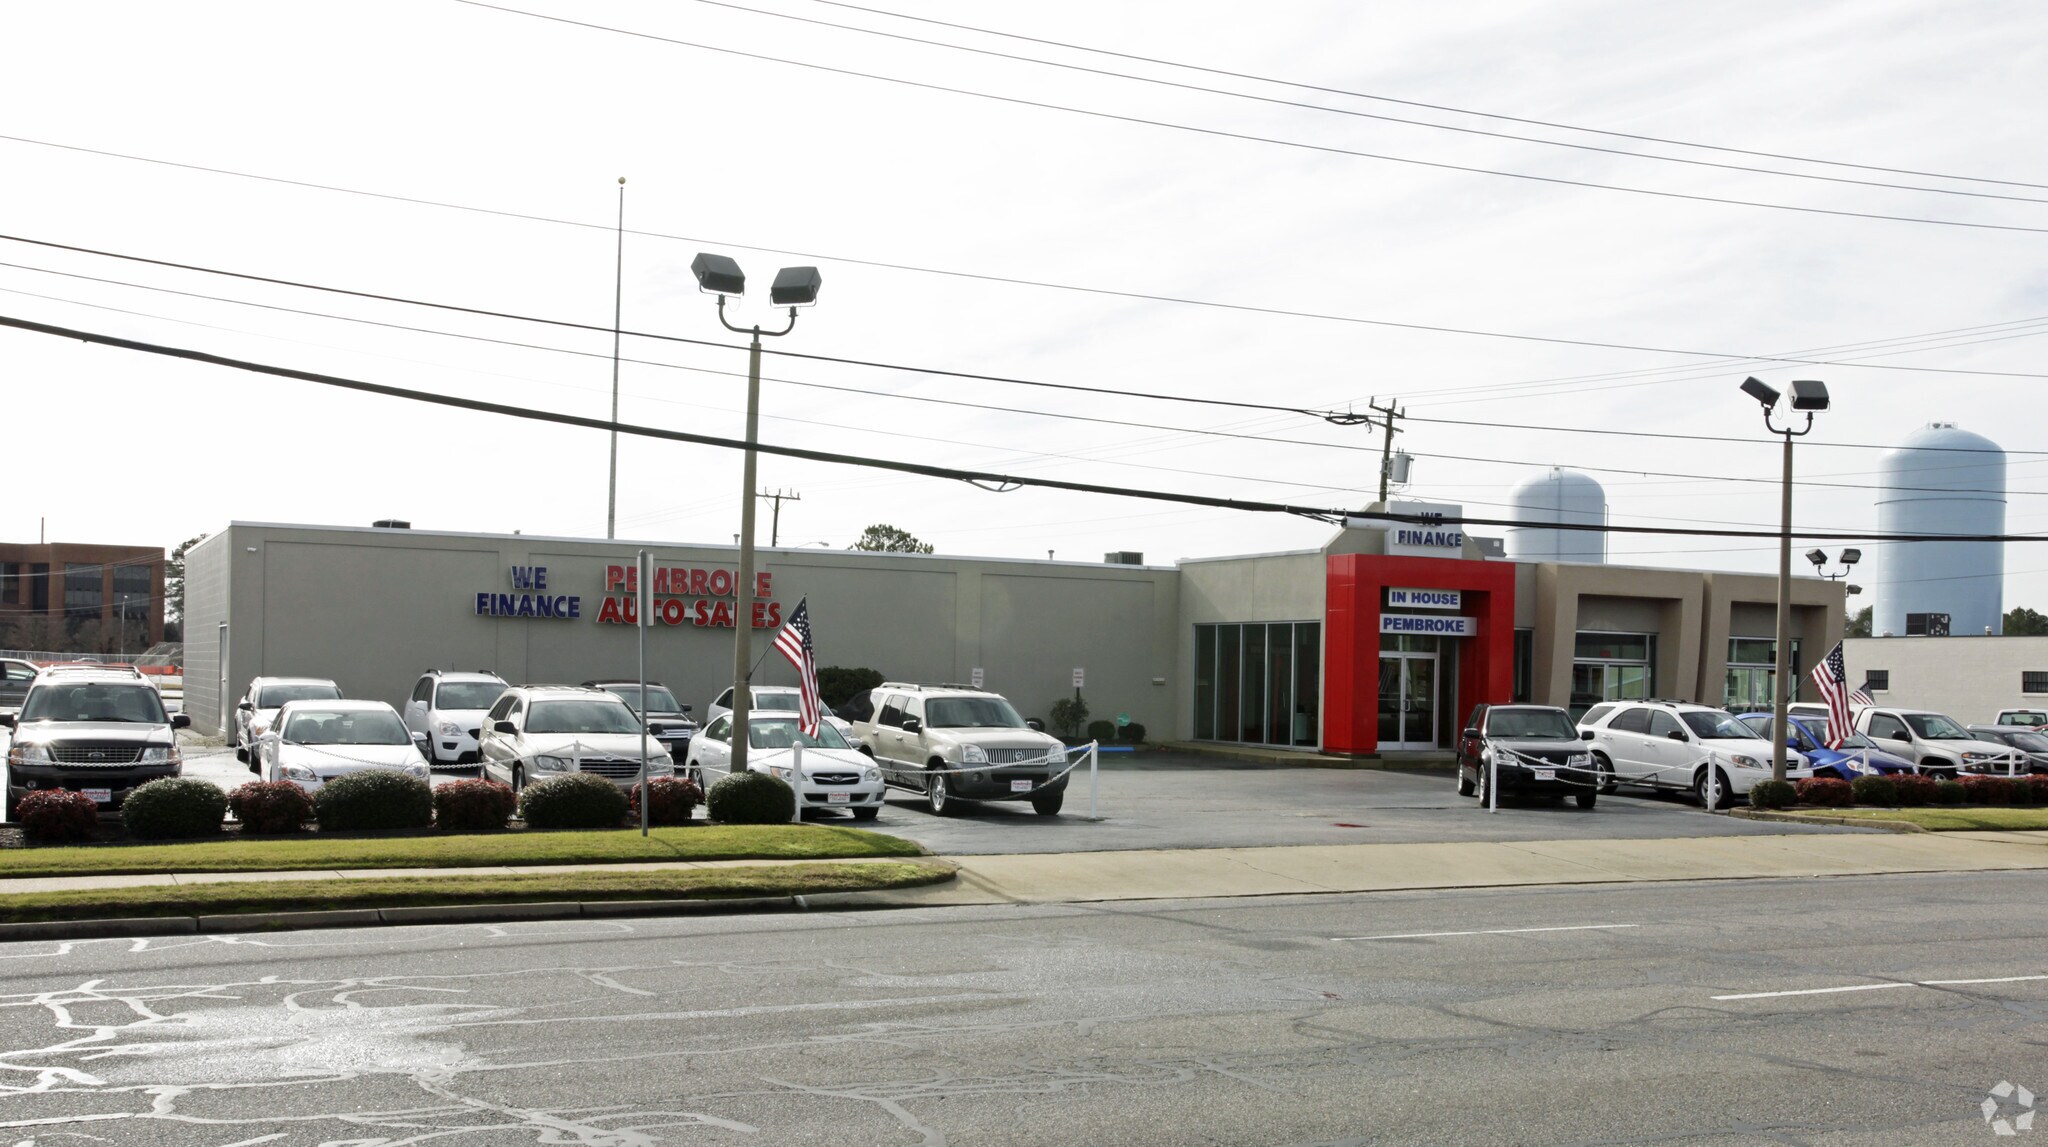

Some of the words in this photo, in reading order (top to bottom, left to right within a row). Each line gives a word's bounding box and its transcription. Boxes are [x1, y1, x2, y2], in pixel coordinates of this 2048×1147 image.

[1396, 529, 1462, 547] FINANCE
[511, 565, 547, 590] WE
[606, 564, 773, 598] PEMBROE
[475, 592, 580, 618] FINANCE
[1392, 591, 1406, 603] IN
[1411, 592, 1458, 605] HOUSE
[1383, 617, 1465, 633] PEMBROKE
